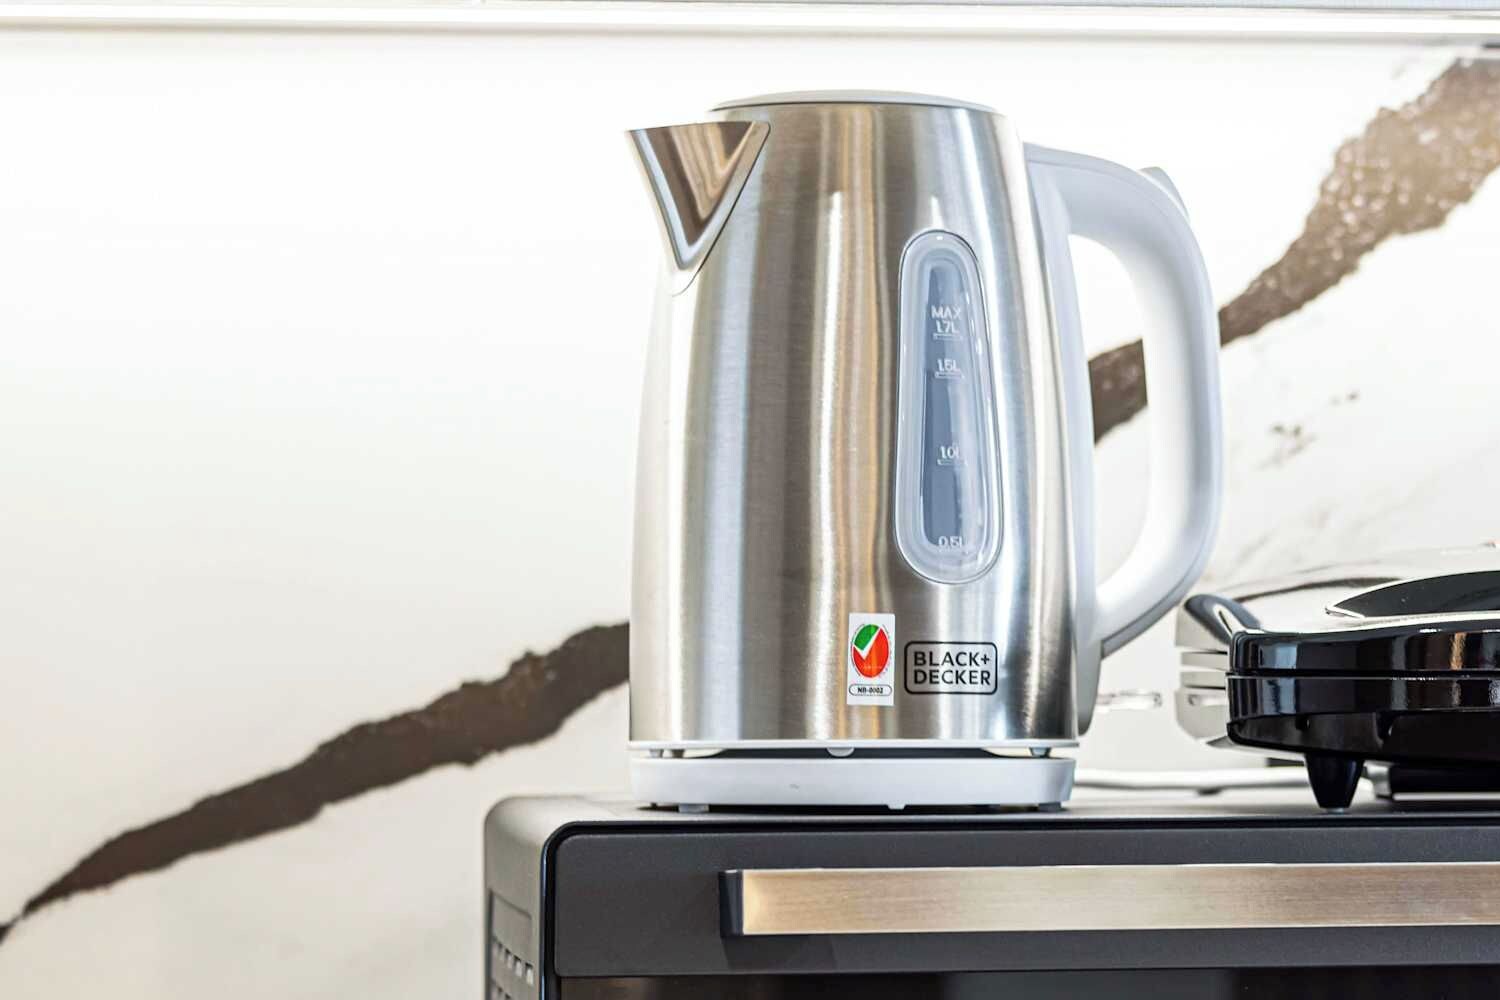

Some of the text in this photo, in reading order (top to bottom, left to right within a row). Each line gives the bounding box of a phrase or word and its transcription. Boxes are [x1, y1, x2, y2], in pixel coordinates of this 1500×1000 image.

[931, 305, 960, 319] MAX
[913, 651, 990, 667] BLACK+
[914, 669, 991, 685] DECKER
